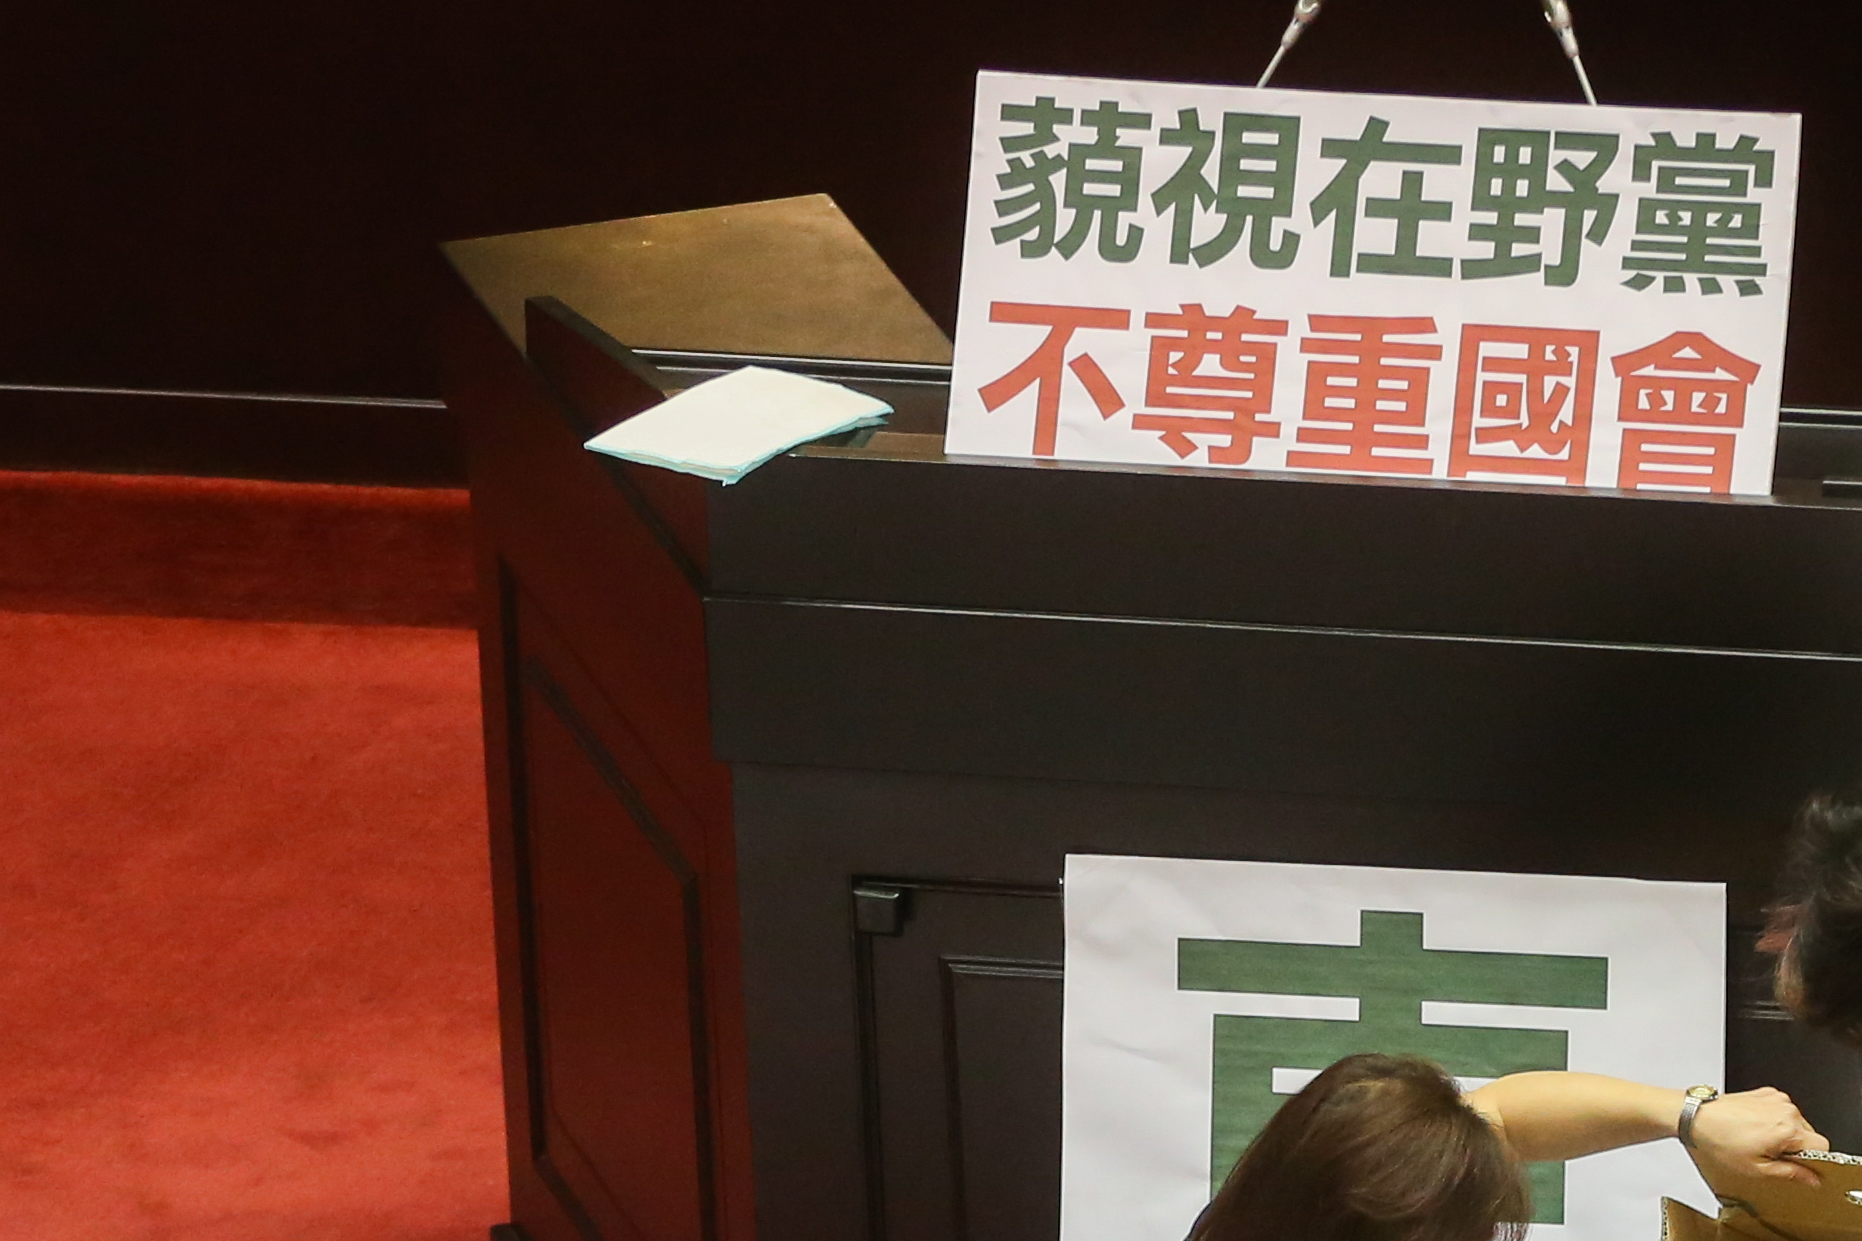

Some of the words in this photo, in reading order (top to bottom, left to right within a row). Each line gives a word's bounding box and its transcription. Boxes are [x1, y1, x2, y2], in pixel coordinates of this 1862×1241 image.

[990, 96, 1777, 297] 藐視在野黨
[977, 301, 1762, 494] 不尊重國會
